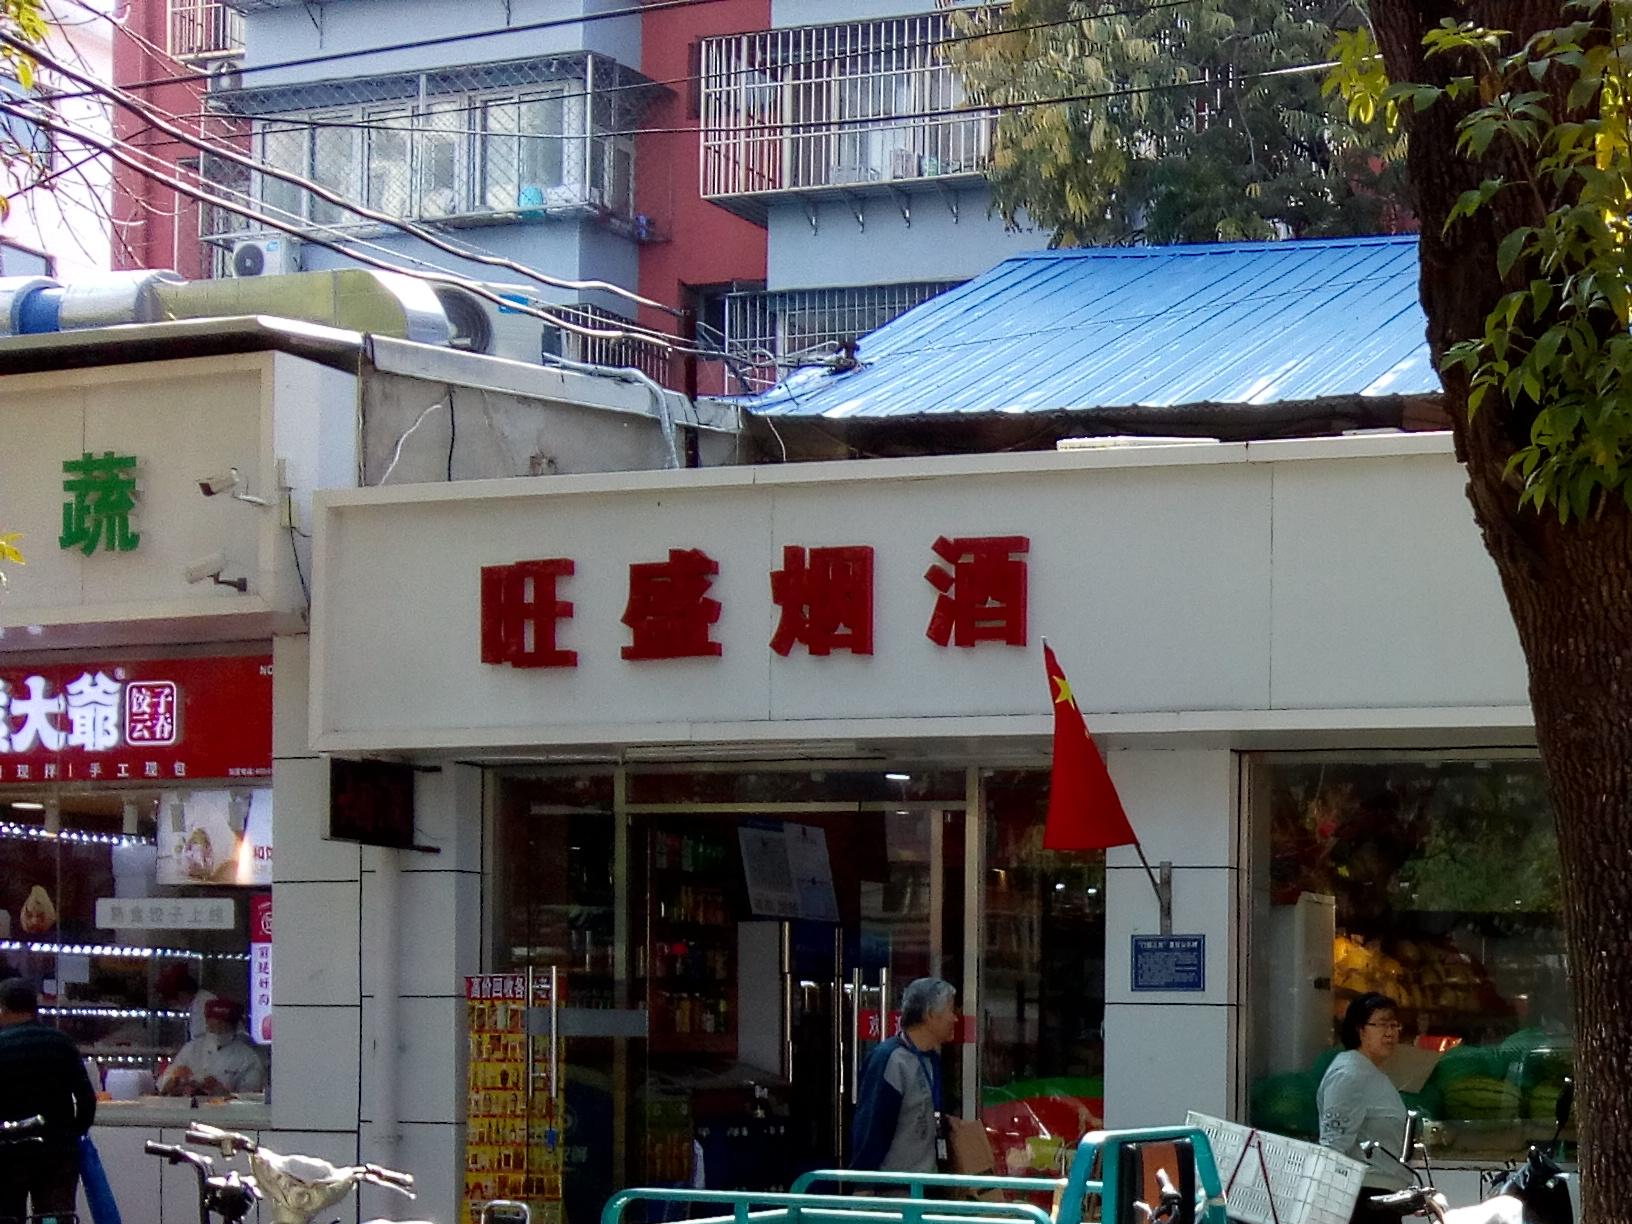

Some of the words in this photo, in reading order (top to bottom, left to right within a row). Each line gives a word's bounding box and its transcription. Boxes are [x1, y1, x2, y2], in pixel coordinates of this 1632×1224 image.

[58, 451, 140, 557] 蔬
[481, 536, 1030, 668] 旺盛烟酒
[0, 671, 121, 752] 大爷
